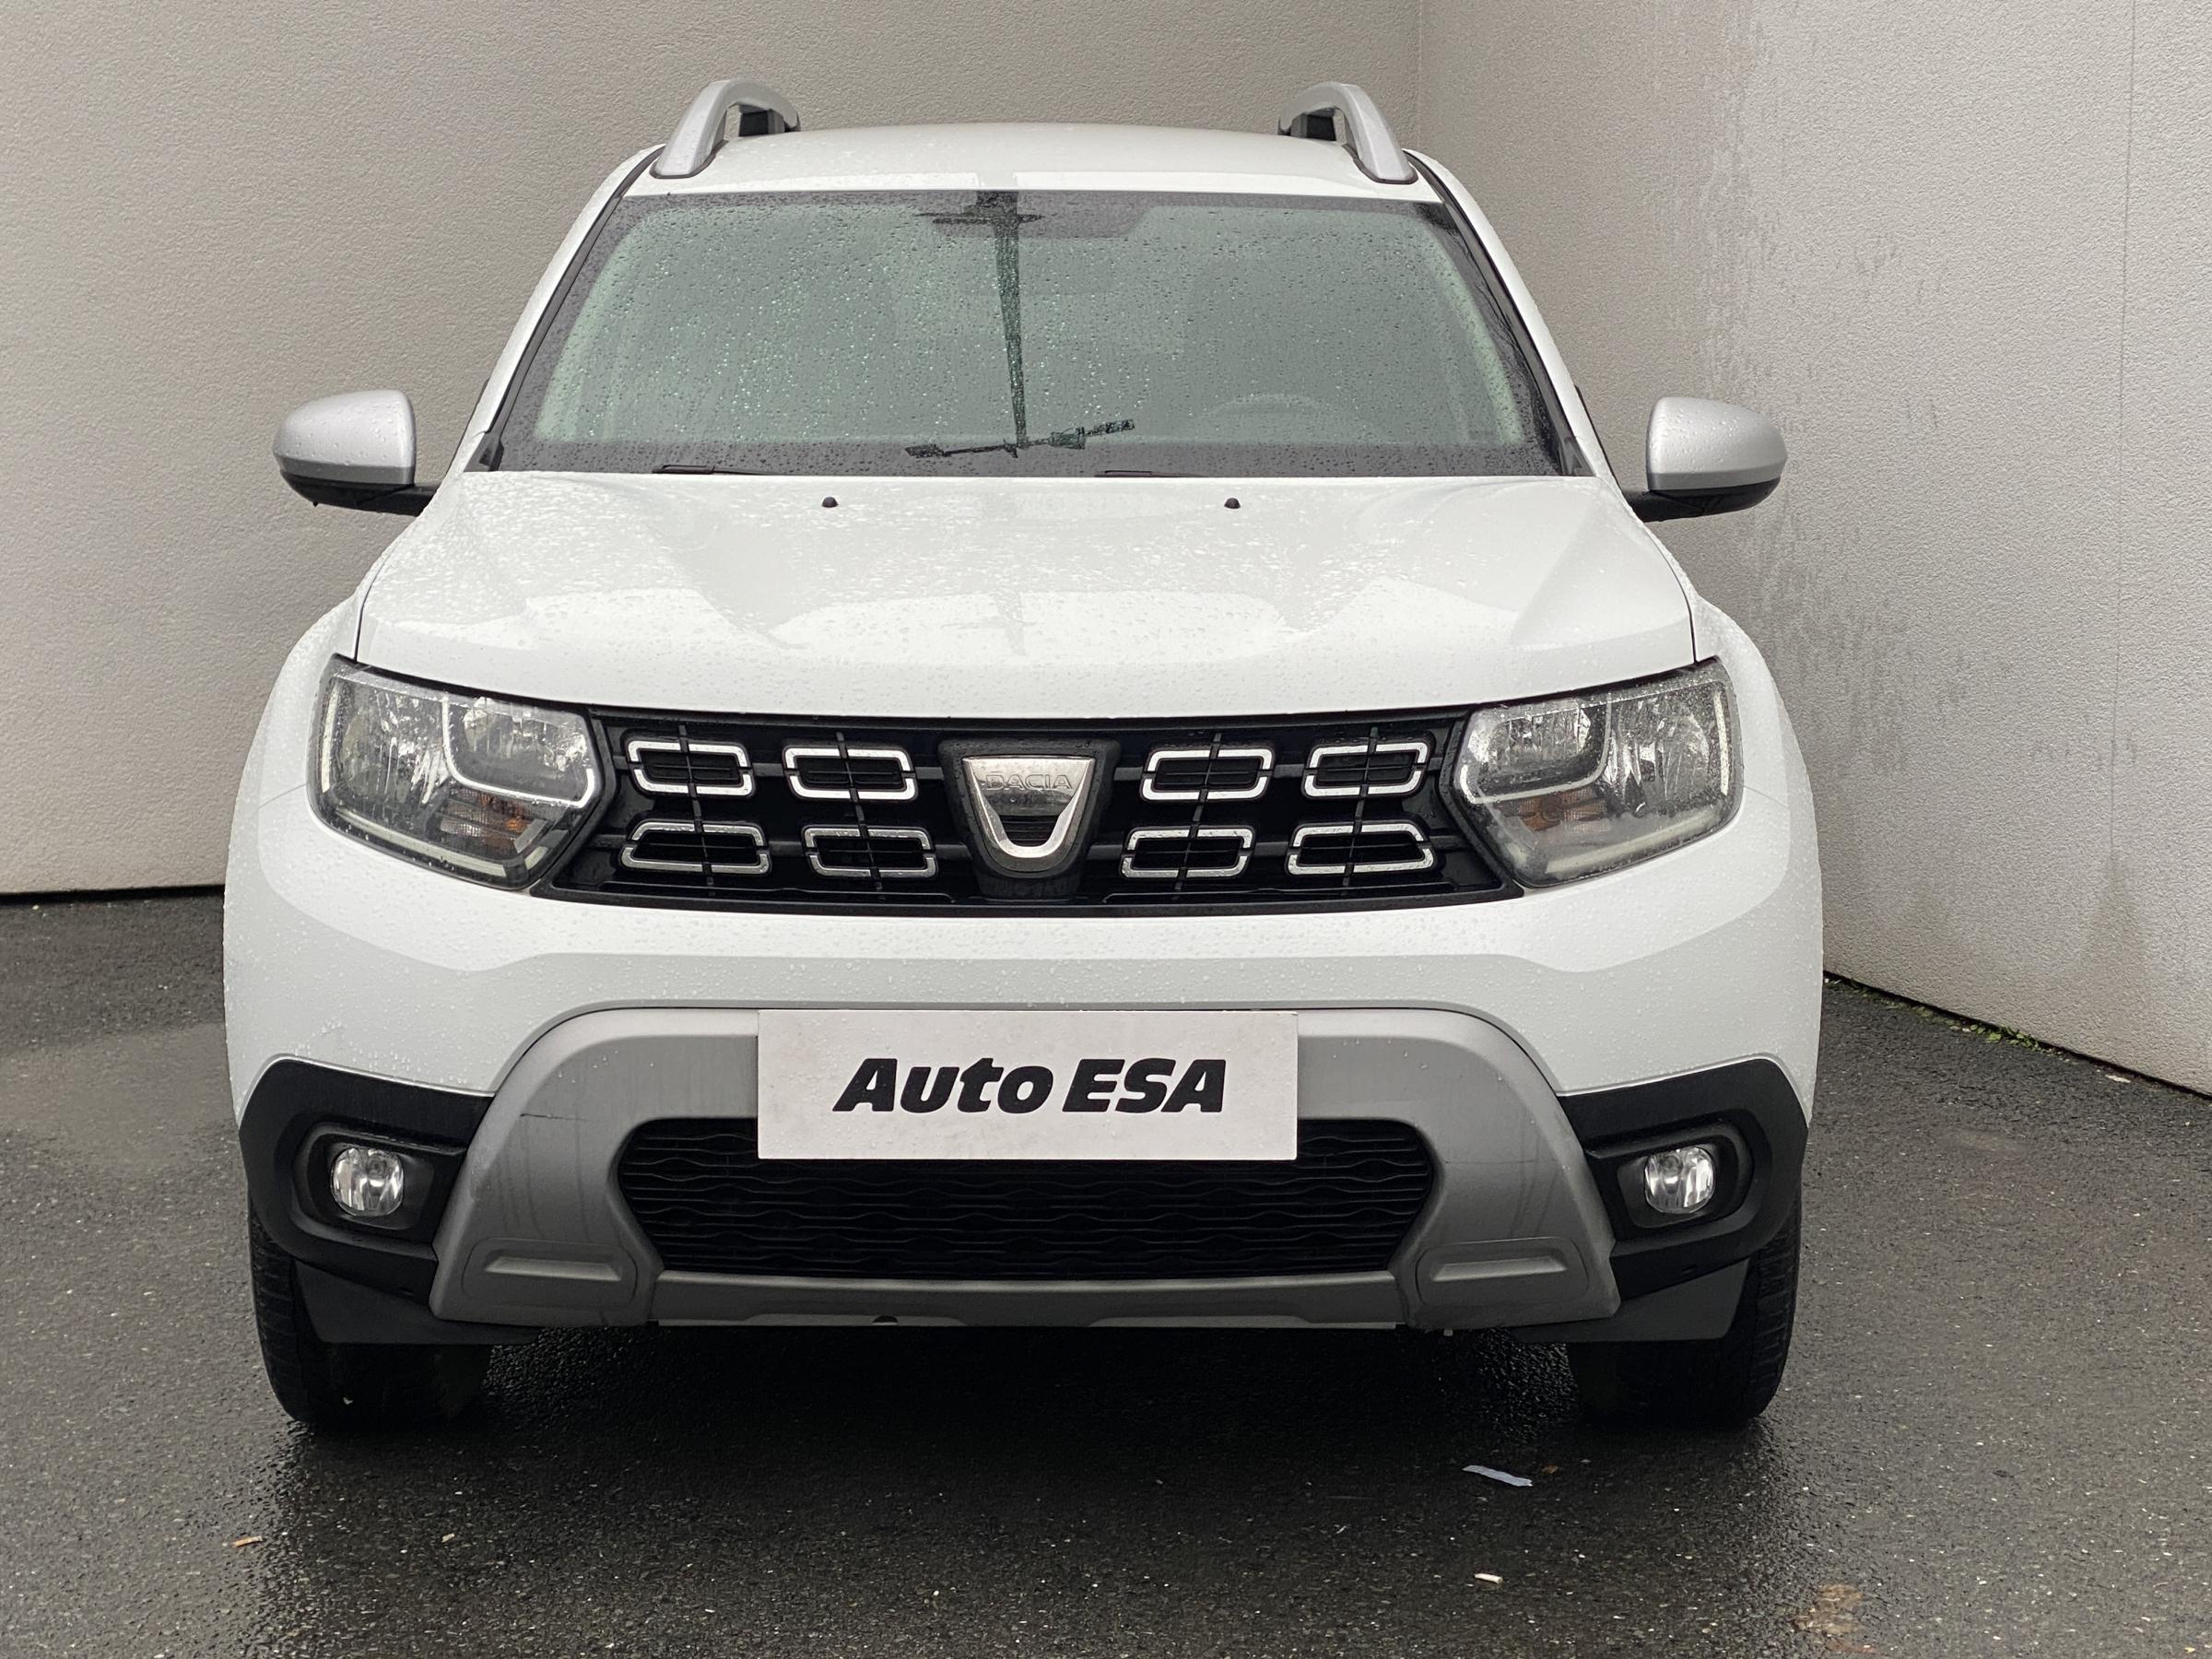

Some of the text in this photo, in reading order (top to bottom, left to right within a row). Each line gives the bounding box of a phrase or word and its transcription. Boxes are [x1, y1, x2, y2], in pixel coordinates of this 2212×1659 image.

[985, 773, 1073, 791] DACIA
[831, 1057, 1227, 1114] Auto ESA
